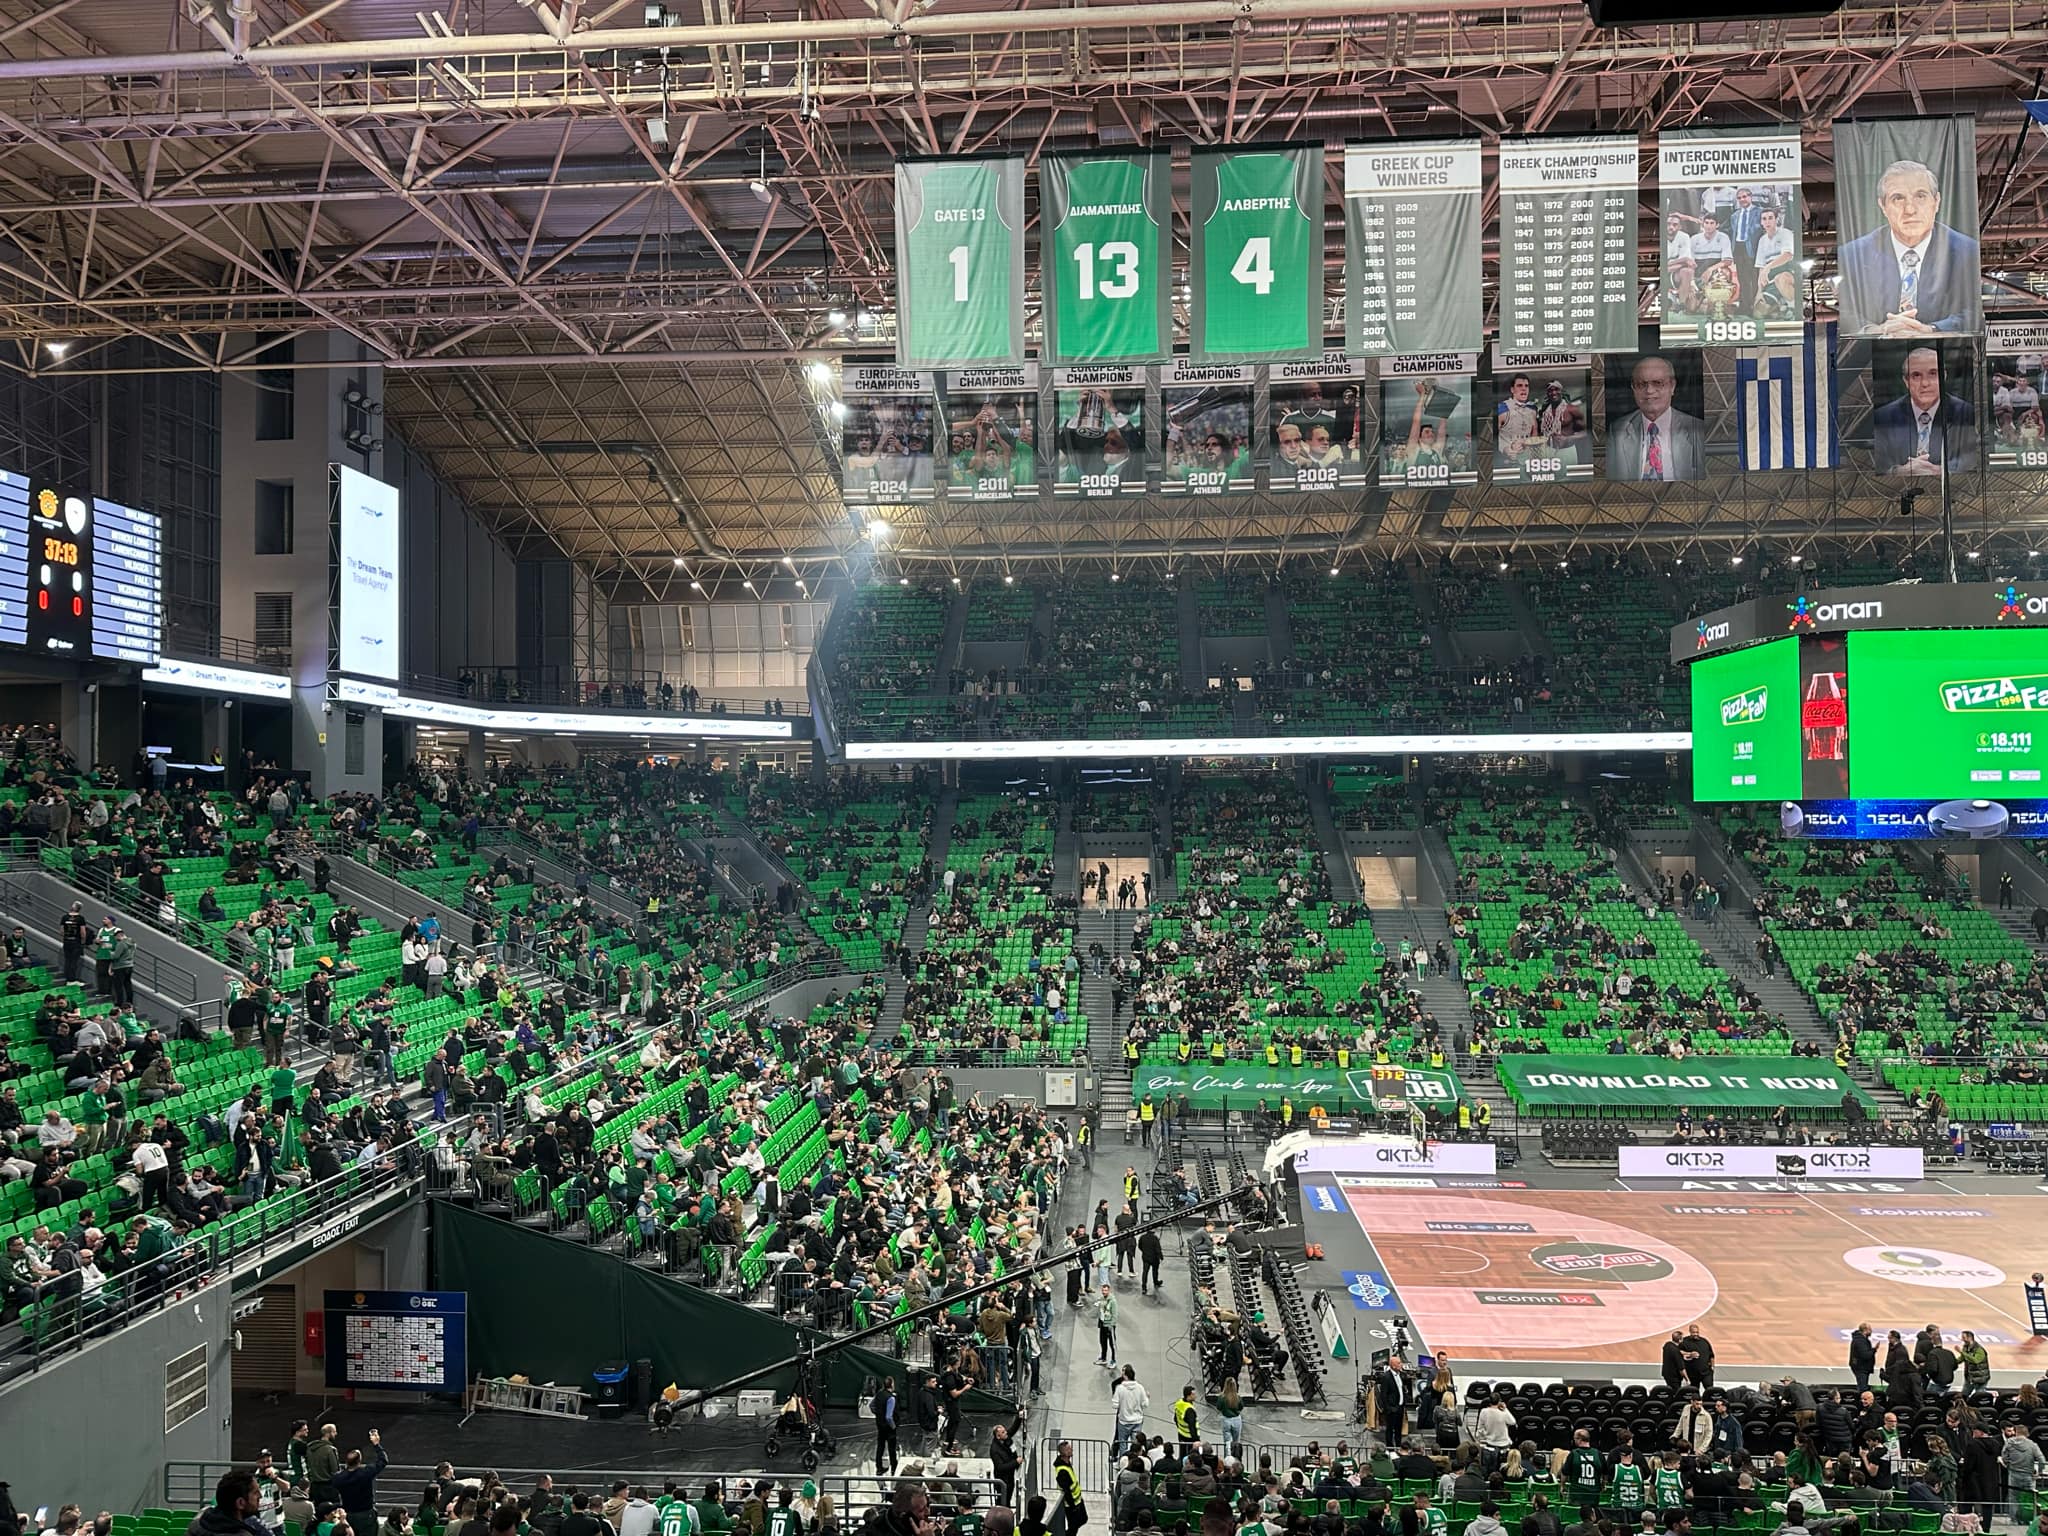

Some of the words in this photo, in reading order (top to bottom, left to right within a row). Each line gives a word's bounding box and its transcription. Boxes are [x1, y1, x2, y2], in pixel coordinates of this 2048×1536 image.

[1504, 157, 1541, 169] GREEK
[1545, 154, 1636, 168] CHAMPIONSHIP
[1665, 148, 1794, 164] INTERCONTINENTAL
[1371, 157, 1419, 171] GREEK
[1424, 156, 1454, 169] CUP
[1682, 163, 1709, 176] CUP
[1711, 161, 1776, 175] WINNERS
[1376, 172, 1448, 186] WINNERS
[1541, 168, 1597, 180] WINNERS
[1070, 204, 1142, 216] ΔΙΑΜΑΝΤΙΔΗΣ
[1223, 197, 1291, 212] ΑΛΒΕΡΤΗΣ
[934, 209, 968, 222] GATE
[970, 208, 985, 221] 13
[1073, 241, 1139, 300] 13
[1230, 237, 1274, 294] 4
[949, 246, 969, 302] 1
[1704, 322, 1756, 341] 1996
[2002, 338, 2021, 347] CUP
[1393, 360, 1463, 373] CHAMPIONS
[1506, 354, 1577, 366] CHAMPIONS
[859, 370, 916, 380] EUROPEAN
[1174, 369, 1241, 381] CHAMPIONS
[1283, 364, 1351, 377] CHAMPIONS
[855, 378, 920, 390] CHAMPIONS
[959, 376, 1025, 388] CHAMPIONS
[1066, 372, 1133, 384] CHAMPIONS
[1407, 465, 1449, 479] 2000
[1524, 458, 1562, 473] 1996
[1080, 474, 1120, 488] 2009
[1188, 472, 1227, 486] 2007
[1297, 469, 1338, 482] 2002
[1531, 472, 1555, 482] PARIS
[870, 480, 908, 494] 2024
[978, 478, 1008, 491] 2011
[1193, 486, 1221, 494] ATHENS
[45, 538, 78, 565] 37:13
[358, 560, 377, 575] Dream
[379, 566, 393, 580] Team
[1990, 732, 2032, 746] 18.111
[1805, 814, 1847, 825] TESLA
[1867, 814, 1925, 824] TESLA
[1148, 1075, 1188, 1090] One
[1193, 1075, 1248, 1091] Club
[1291, 1079, 1333, 1093] App
[1361, 1079, 1448, 1097] 108
[1526, 1074, 1711, 1089] DOWNLOAD
[1720, 1076, 1750, 1089] IT
[1760, 1077, 1840, 1090] NOW
[149, 1147, 161, 1158] 10
[1681, 1180, 1905, 1192] ATHENS
[1673, 1207, 1795, 1215] instacar
[312, 1225, 340, 1248] ΕΞΟΔΟΣ
[345, 1216, 359, 1231] EXIT
[1872, 1268, 1996, 1278] COSMOTE
[1484, 1293, 1594, 1304] ecommbx
[1581, 1464, 1594, 1478] 10
[1620, 1487, 1638, 1501] 25
[663, 1520, 680, 1536] 10
[770, 1520, 786, 1536] 10
